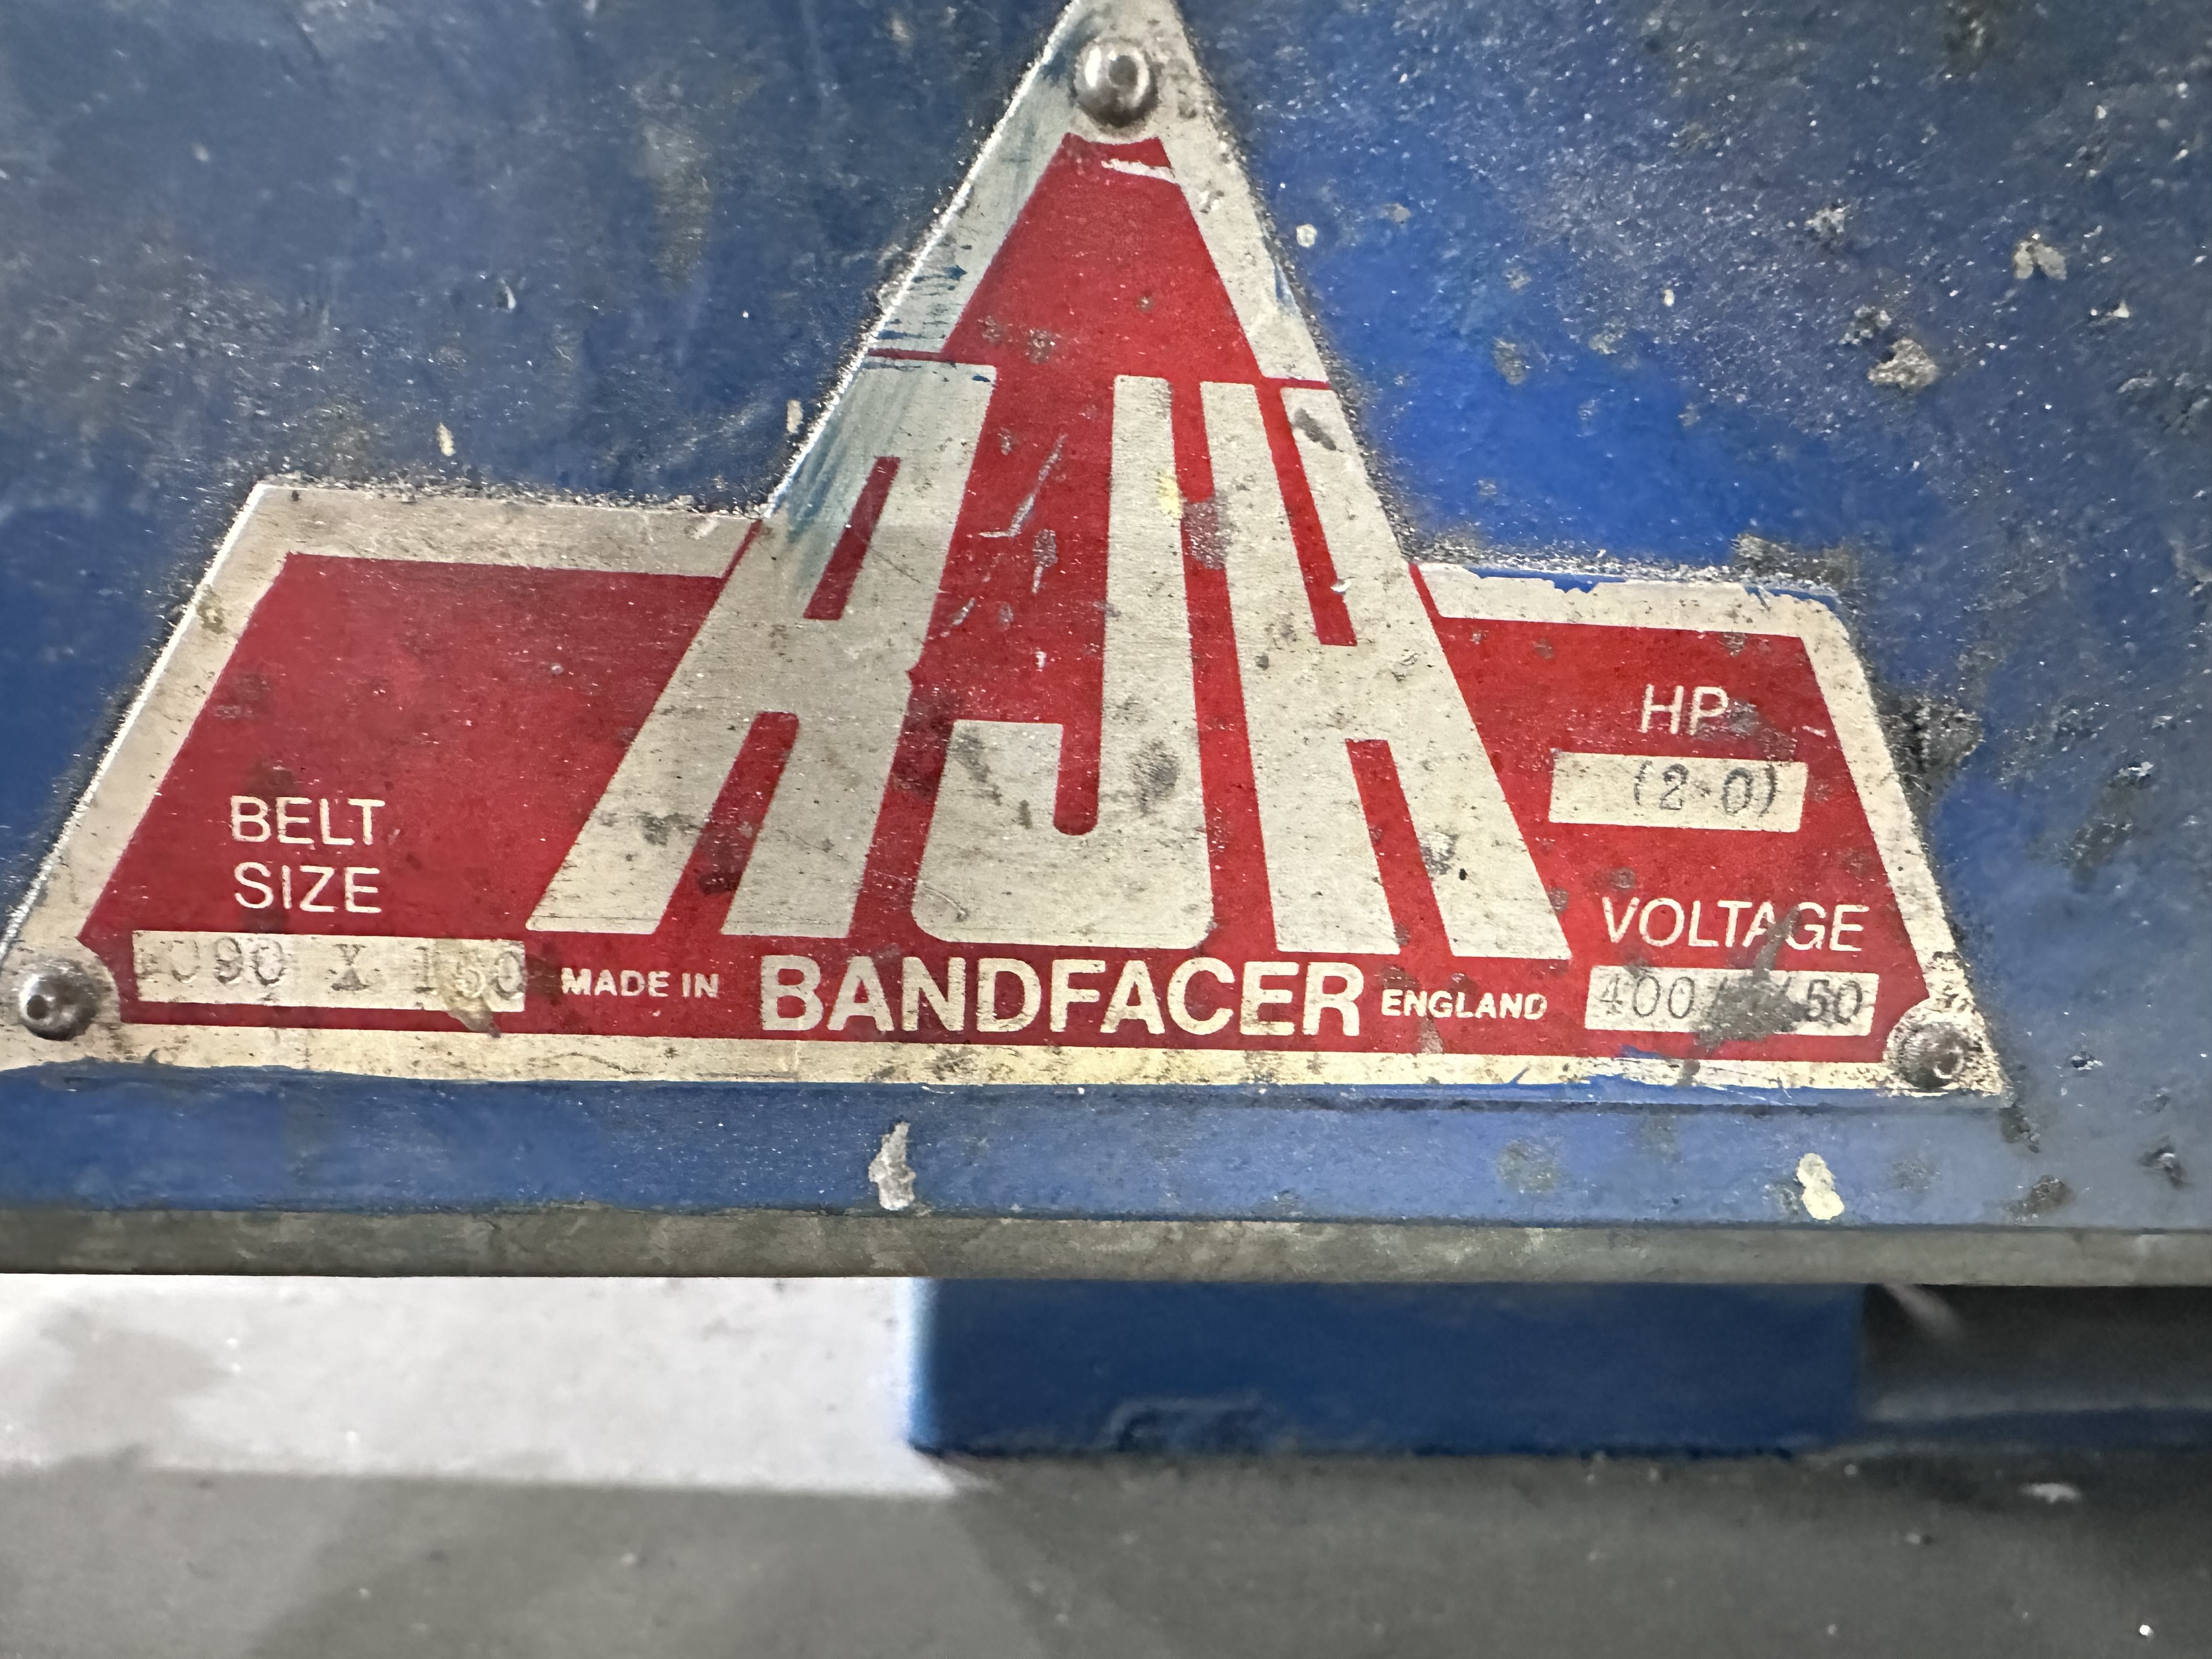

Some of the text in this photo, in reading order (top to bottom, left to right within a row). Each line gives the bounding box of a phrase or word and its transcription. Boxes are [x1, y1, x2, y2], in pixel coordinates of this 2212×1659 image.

[1639, 684, 1729, 735] HP
[230, 795, 385, 845] BELT
[234, 861, 382, 913] SIZE
[1601, 896, 1870, 951] VOLTAGE
[561, 967, 719, 999] MADE IN
[760, 954, 1365, 1037] BANDFACER
[1381, 989, 1547, 1020] ENGLAND
